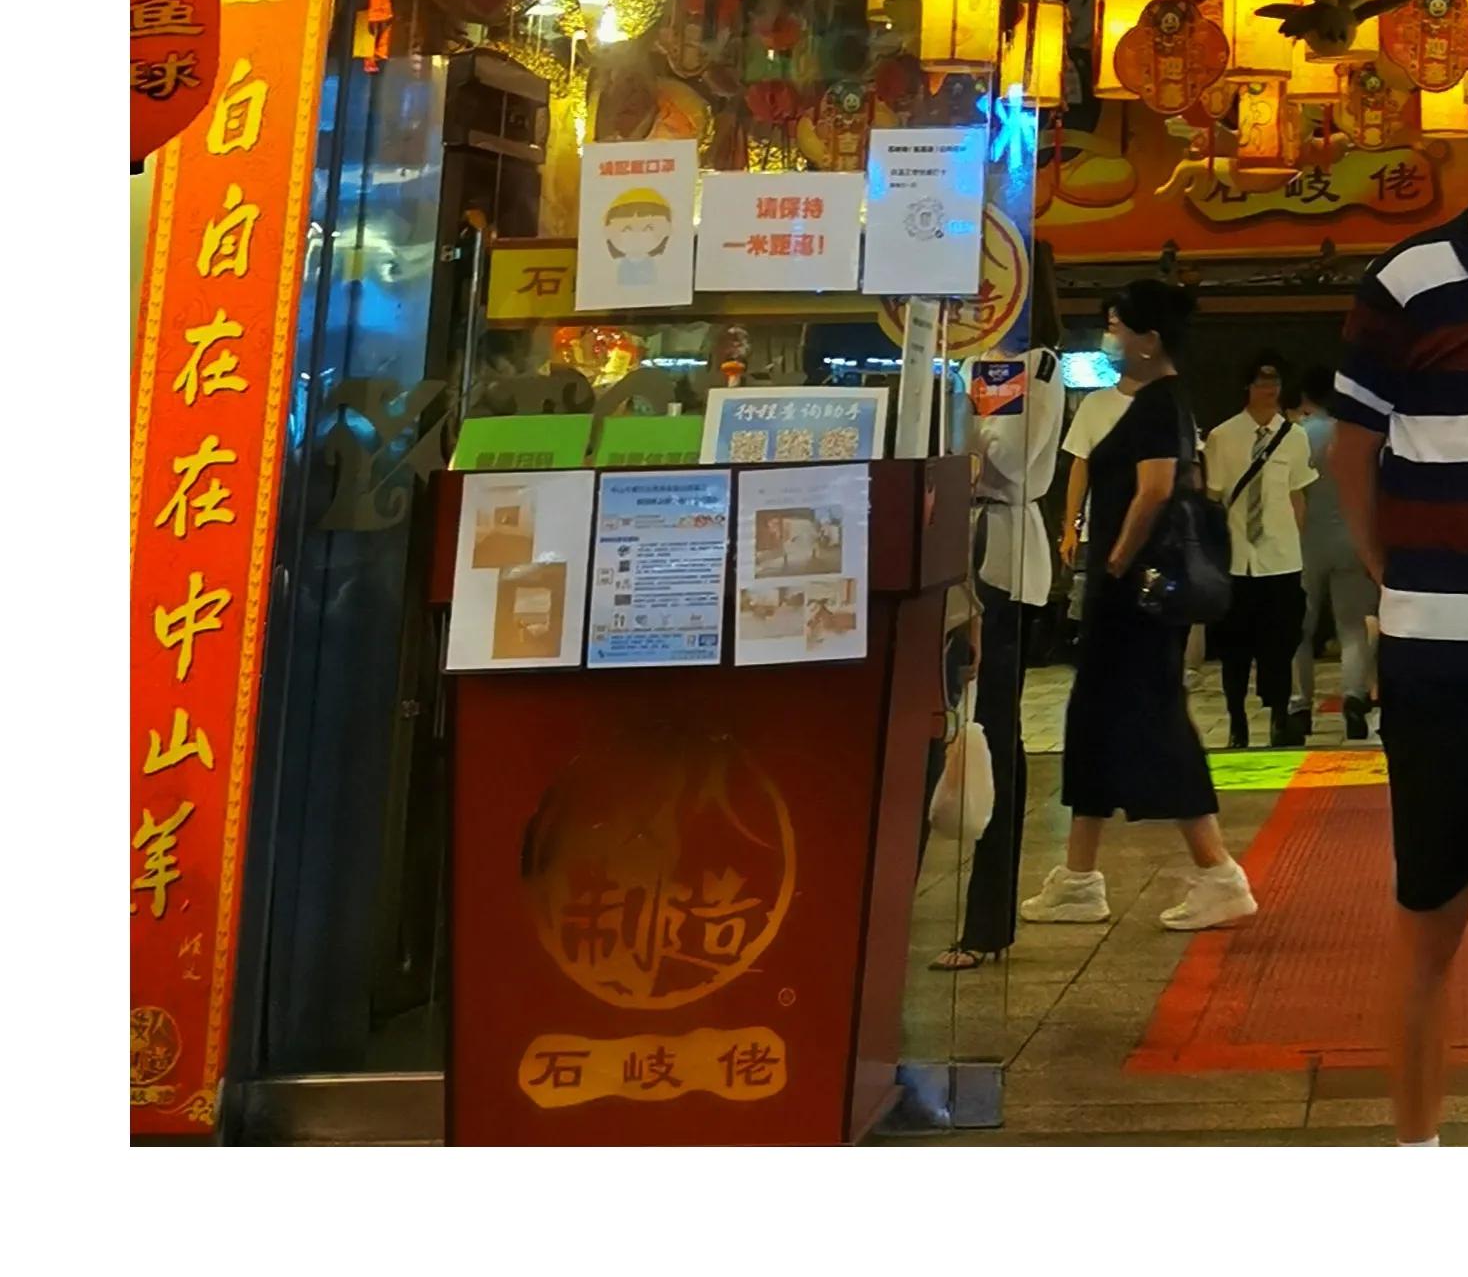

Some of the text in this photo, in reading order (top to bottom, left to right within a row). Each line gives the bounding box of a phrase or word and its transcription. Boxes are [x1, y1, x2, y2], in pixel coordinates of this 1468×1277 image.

[756, 196, 824, 220] 请保持
[528, 1042, 780, 1089] 石岐佬
